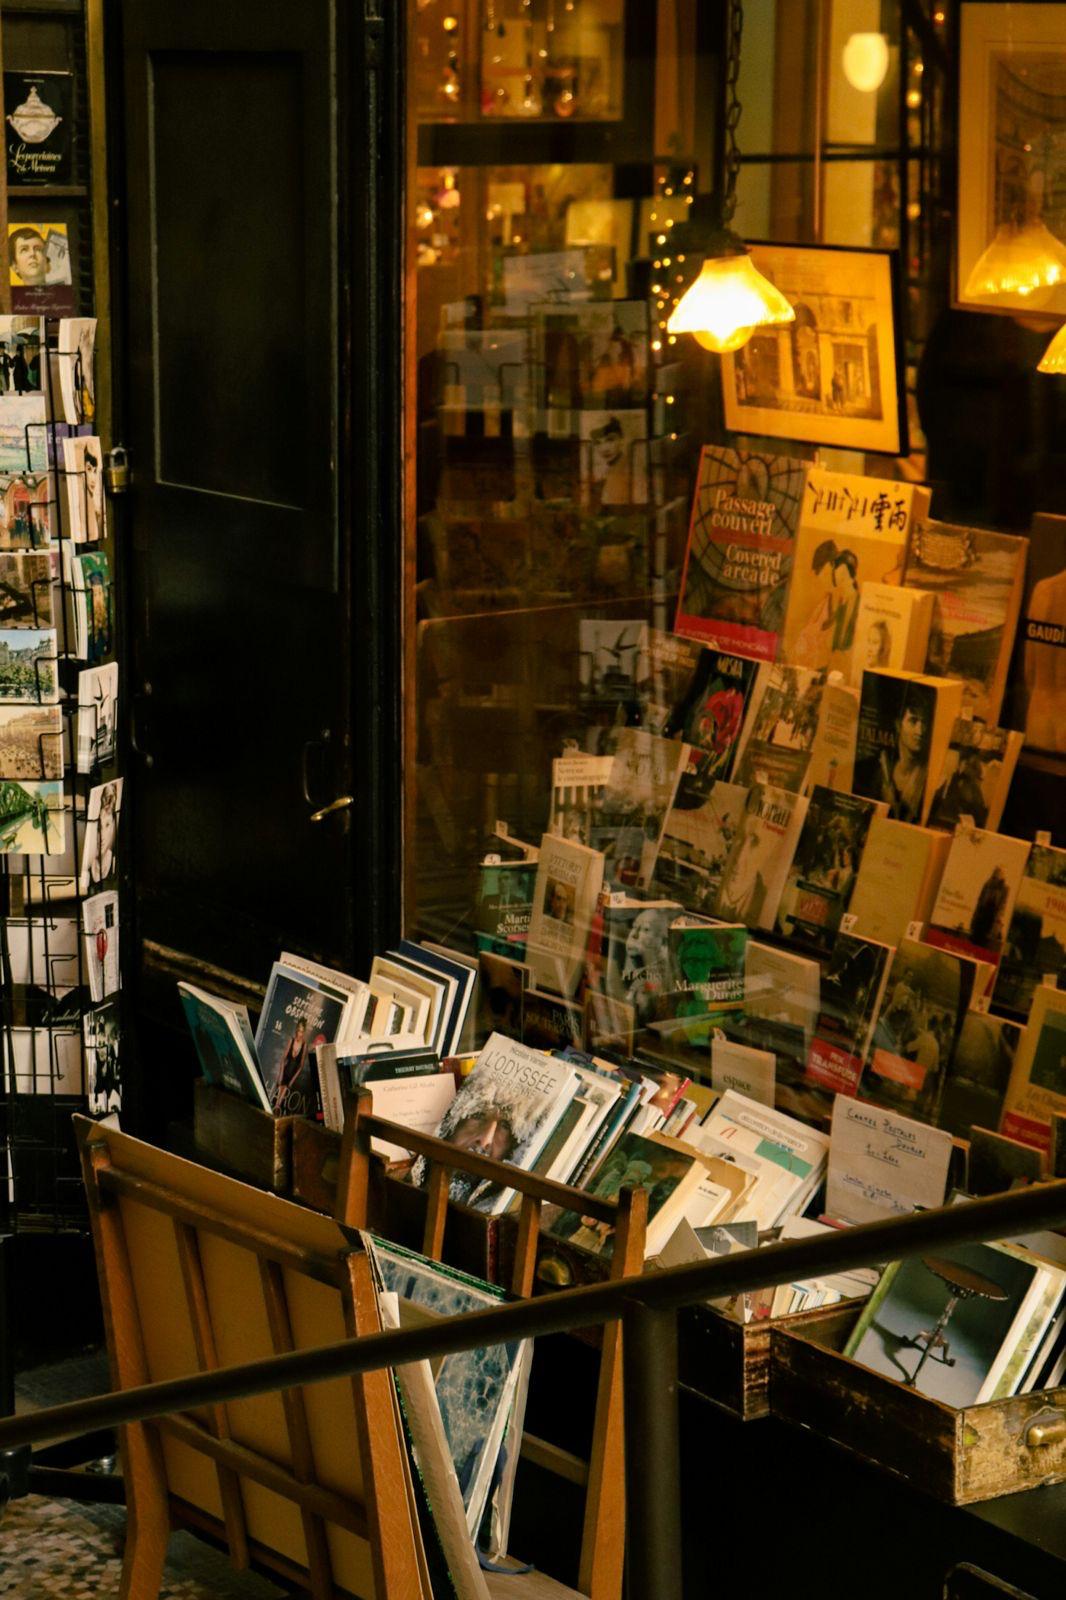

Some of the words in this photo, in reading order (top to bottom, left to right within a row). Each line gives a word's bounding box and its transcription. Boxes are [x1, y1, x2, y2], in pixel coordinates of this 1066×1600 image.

[717, 489, 776, 518] Passage
[711, 511, 773, 536] couvert
[725, 543, 782, 571] Covered
[723, 564, 780, 586] arcade
[504, 913, 531, 925] Marti
[674, 979, 744, 994] Marguerite
[704, 988, 743, 1002] Duras
[484, 1051, 557, 1095] L'ODYSSÉE
